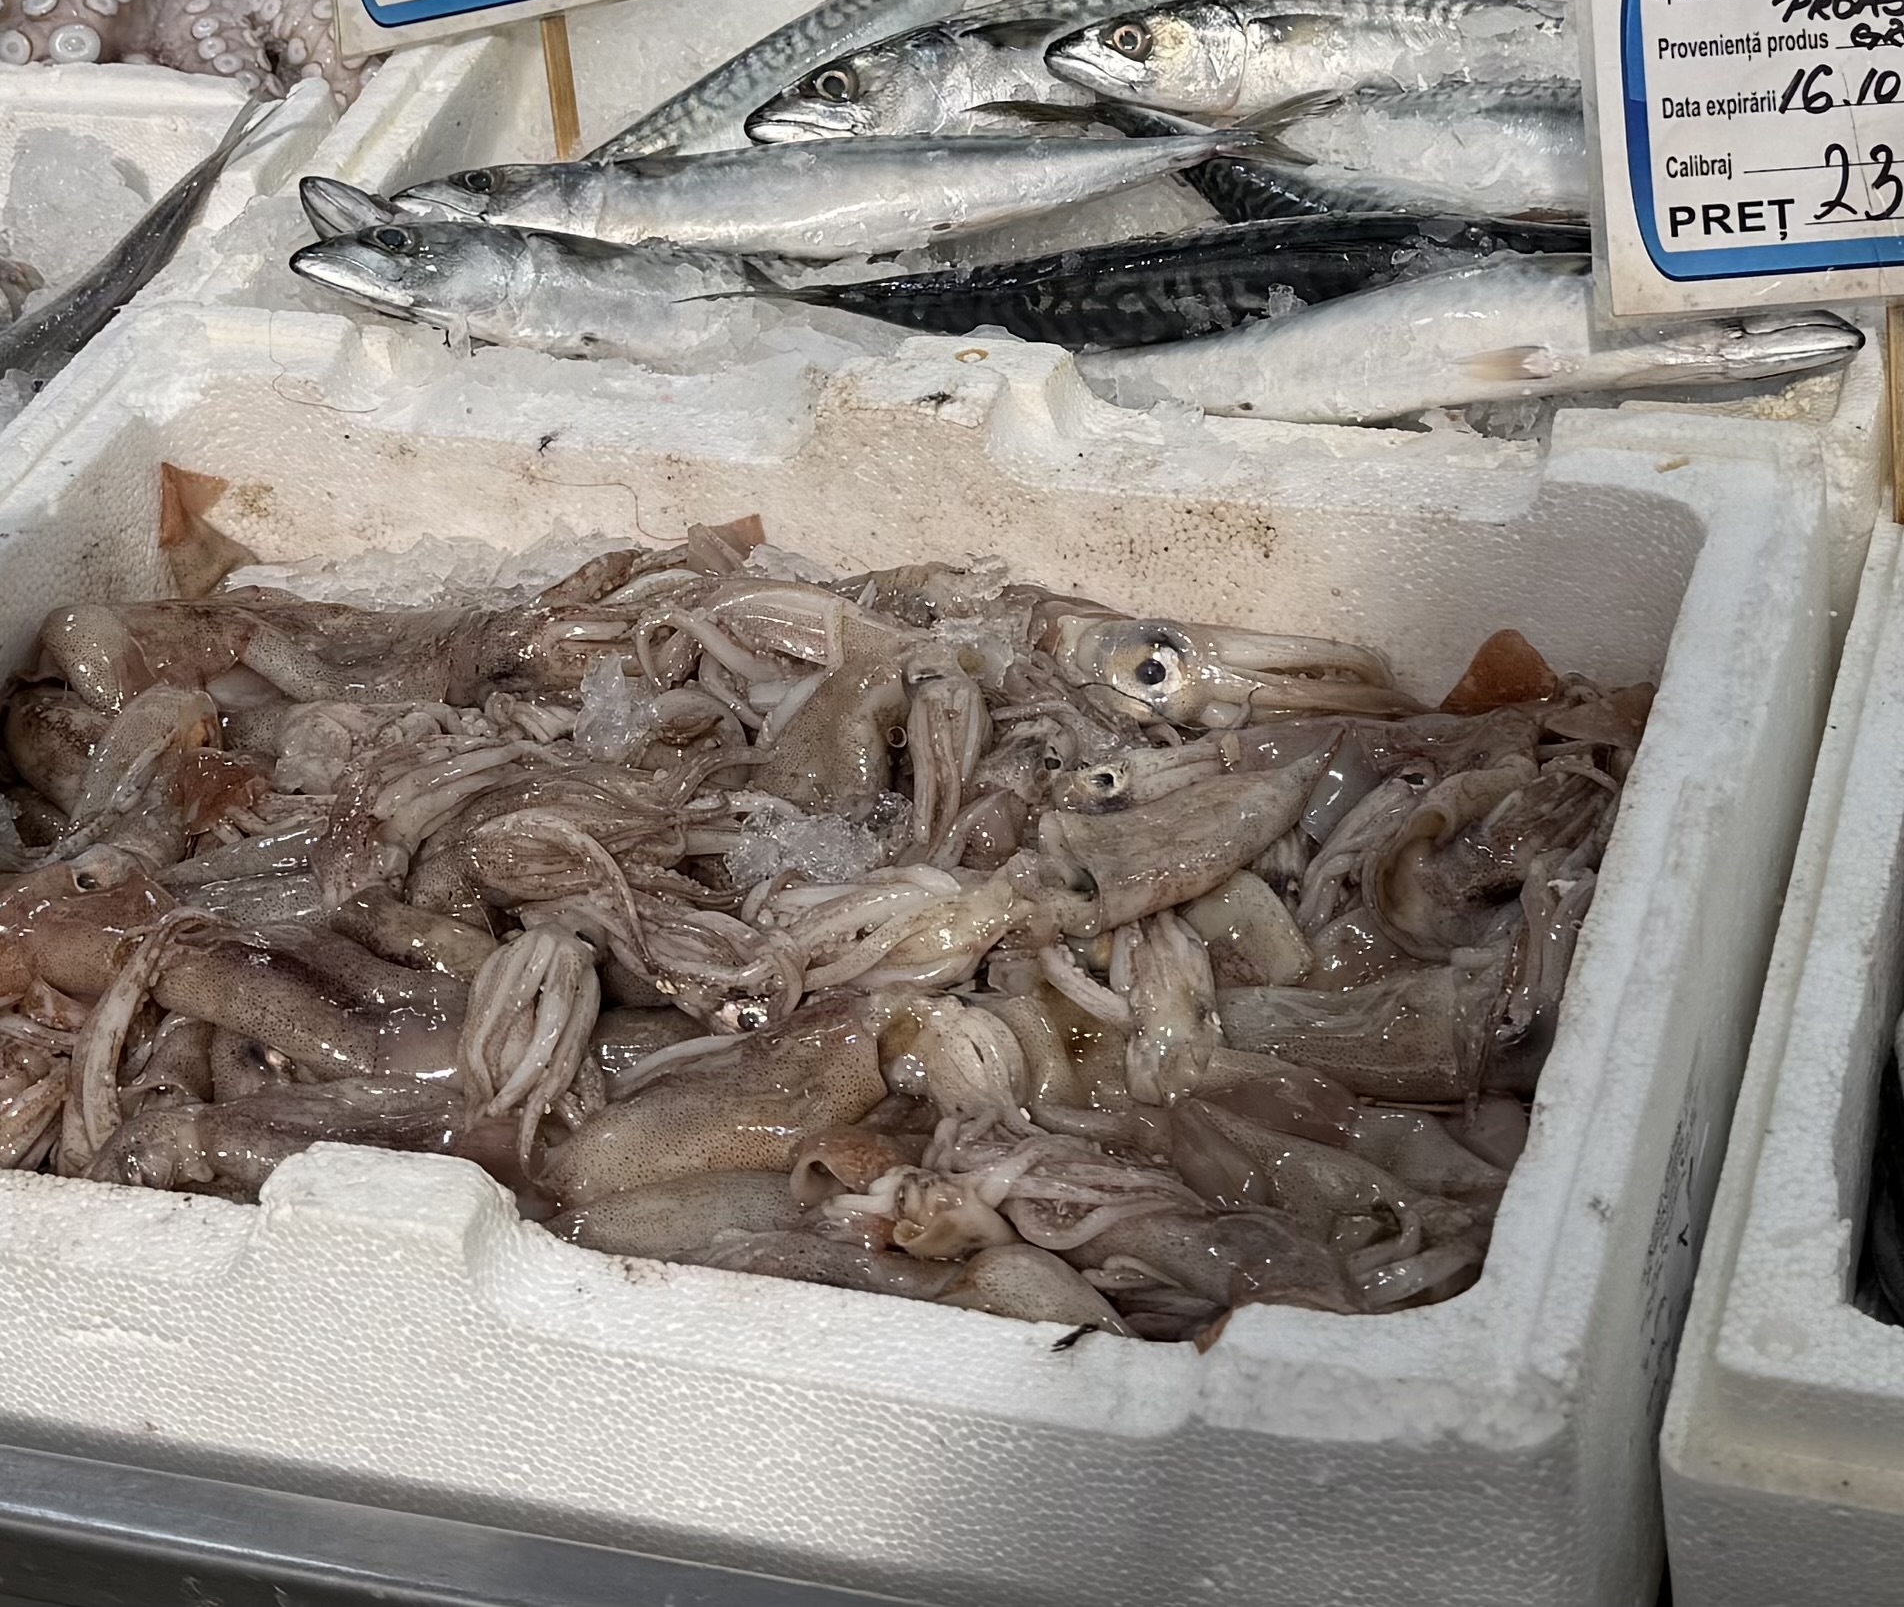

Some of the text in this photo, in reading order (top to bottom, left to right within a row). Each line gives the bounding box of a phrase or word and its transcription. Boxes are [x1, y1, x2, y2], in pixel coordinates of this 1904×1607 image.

[1658, 29, 1763, 61] Proveniență
[1767, 27, 1830, 54] produs
[1662, 96, 1702, 120] Data
[1706, 90, 1778, 121] expirării
[1665, 152, 1733, 180] Calibraj
[1669, 142, 1903, 241] PREȚ 23
